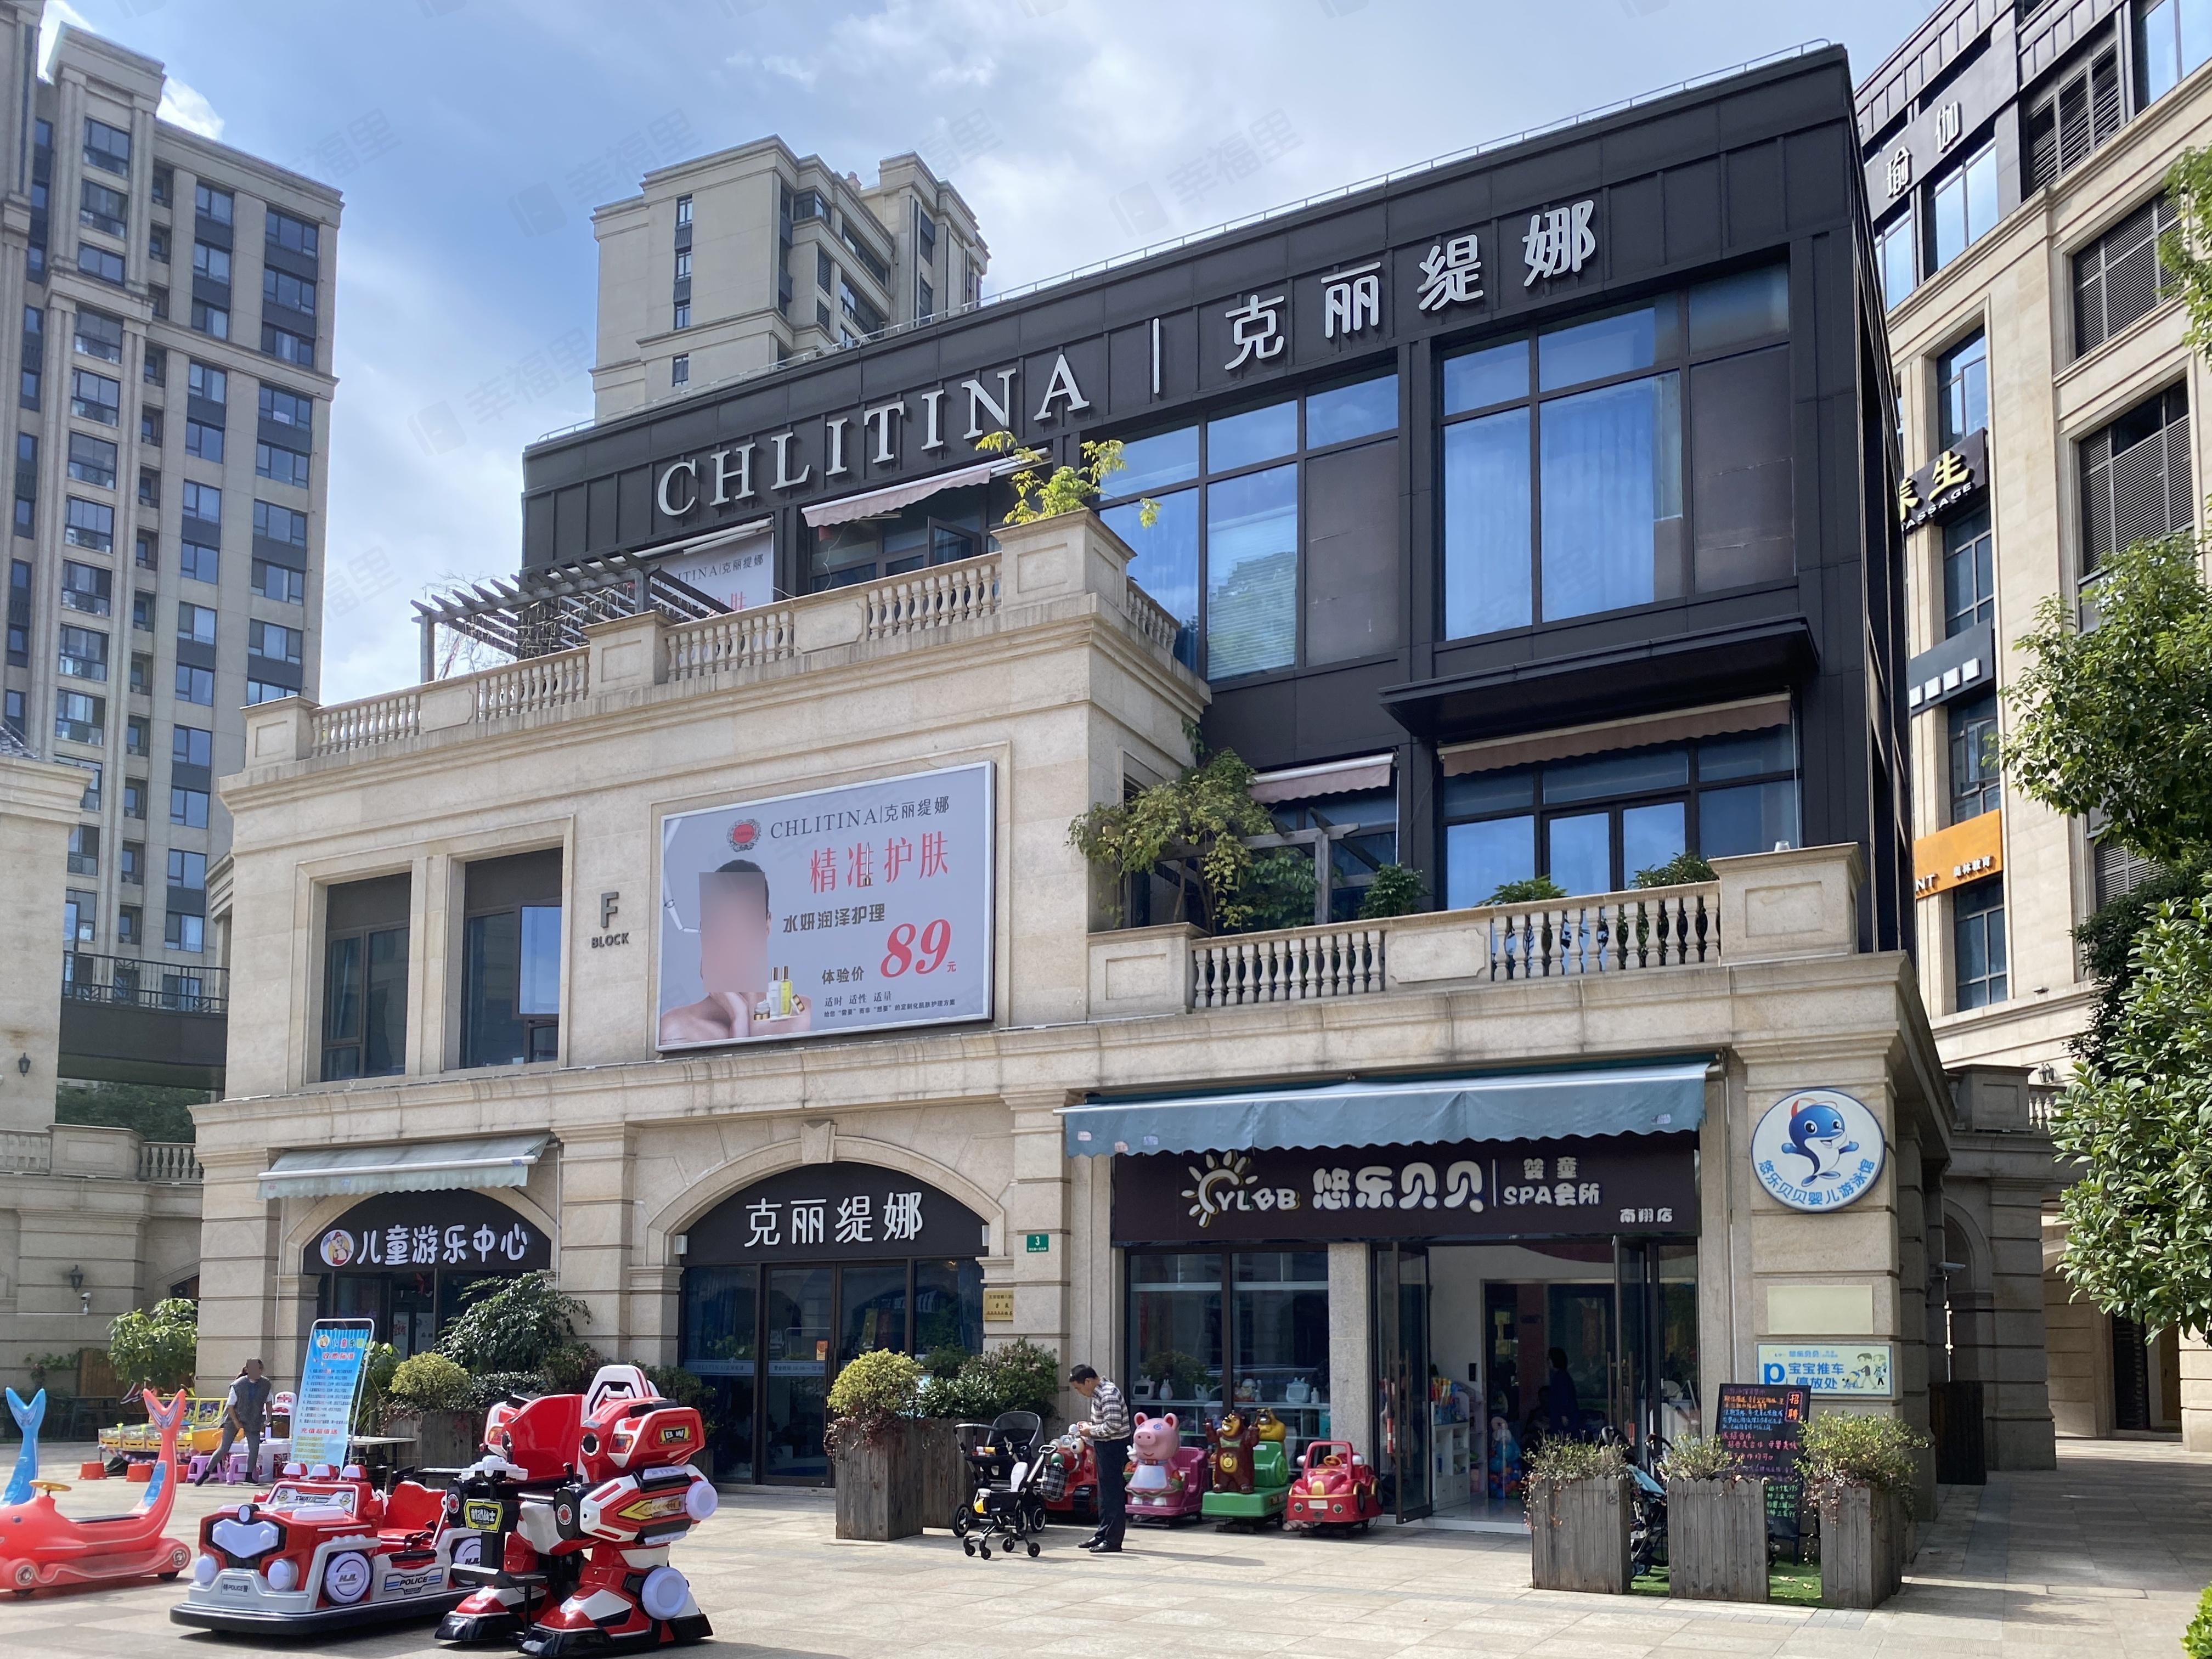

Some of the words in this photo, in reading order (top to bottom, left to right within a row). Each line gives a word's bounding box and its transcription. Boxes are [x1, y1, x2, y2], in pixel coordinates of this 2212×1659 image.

[1225, 198, 1596, 371] 克丽缇娜
[657, 353, 1091, 518] CHLITINA
[1901, 482, 1972, 531] ASSAGE
[722, 554, 764, 574] 克丽缇娜
[770, 808, 877, 839] CHLITINA
[884, 795, 950, 823] 克丽缇娜
[809, 831, 949, 894] 精准护肤
[600, 891, 619, 928] F
[783, 902, 885, 933] 水妍润泽护理
[591, 932, 629, 948] BLOCK
[881, 918, 952, 978] 89
[822, 966, 865, 985] 体验价
[1313, 1160, 1483, 1212] 悠乐贝贝
[1503, 1182, 1600, 1207] SPA会所
[1758, 1159, 1875, 1205] 悠乐贝贝婴儿游泳馆
[743, 1192, 923, 1248] 克丽缇娜
[357, 1222, 528, 1266] 儿童游乐中心
[1035, 1236, 1040, 1246] 3
[1788, 1362, 1845, 1375] 宝宝推车
[1796, 1376, 1838, 1390] 停放处
[399, 1576, 428, 1587] POLICE
